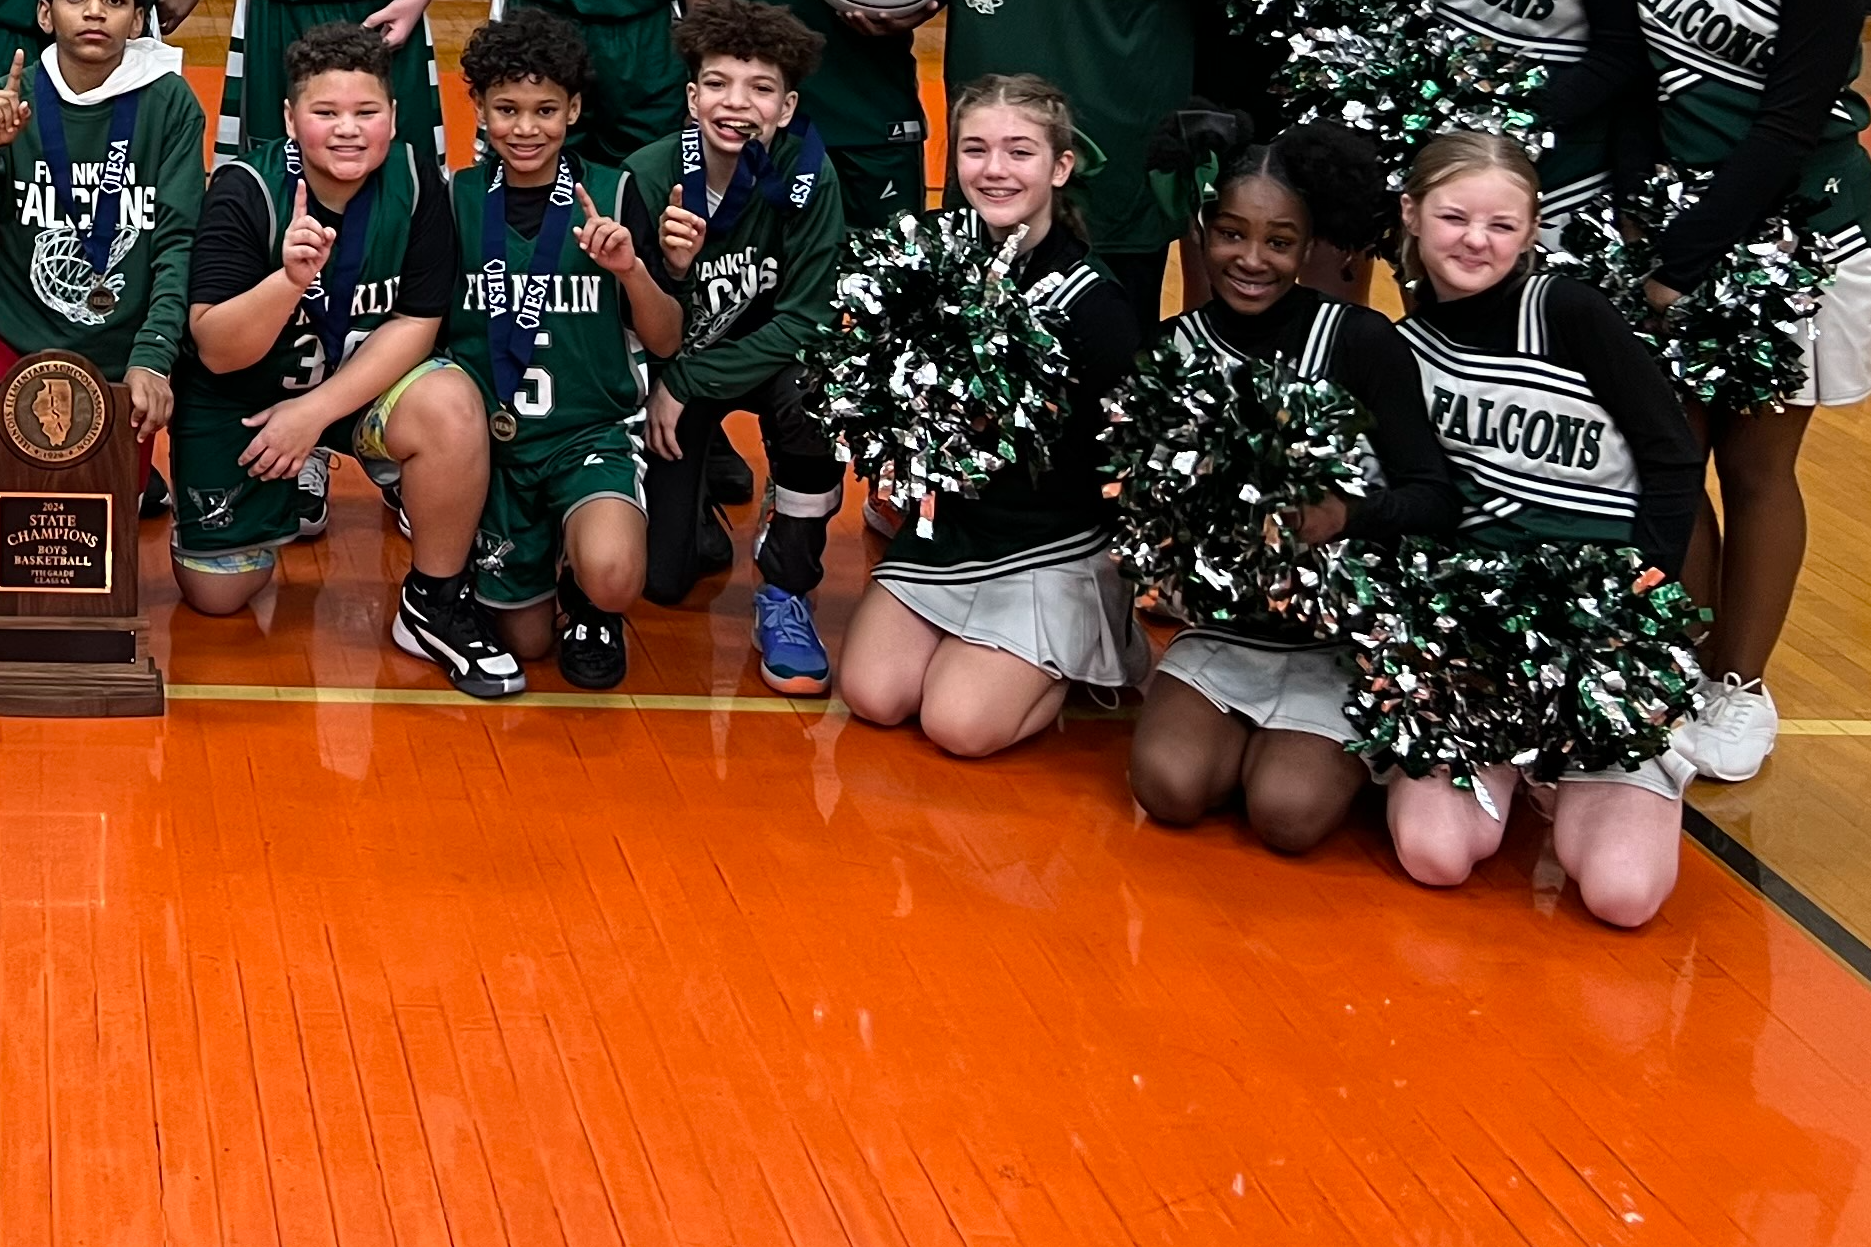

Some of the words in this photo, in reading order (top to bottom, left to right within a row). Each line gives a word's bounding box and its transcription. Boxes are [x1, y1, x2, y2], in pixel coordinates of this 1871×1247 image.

[103, 139, 129, 185] IESA
[681, 134, 701, 175] IESA
[789, 173, 815, 208] ESA
[488, 272, 507, 319] IESA
[523, 274, 550, 319] IESA
[5, 364, 50, 408] ELEMENTARY
[53, 364, 93, 387] SCHOOL
[76, 388, 103, 451] ASSOCIATION
[1433, 384, 1606, 471] FALCONS
[29, 514, 76, 527] STATE
[42, 502, 64, 512] 2024
[7, 528, 99, 548] CHAMPIONS
[37, 545, 68, 555] BOYS
[14, 555, 92, 567] BASKETBALL
[47, 569, 75, 578] GRADE
